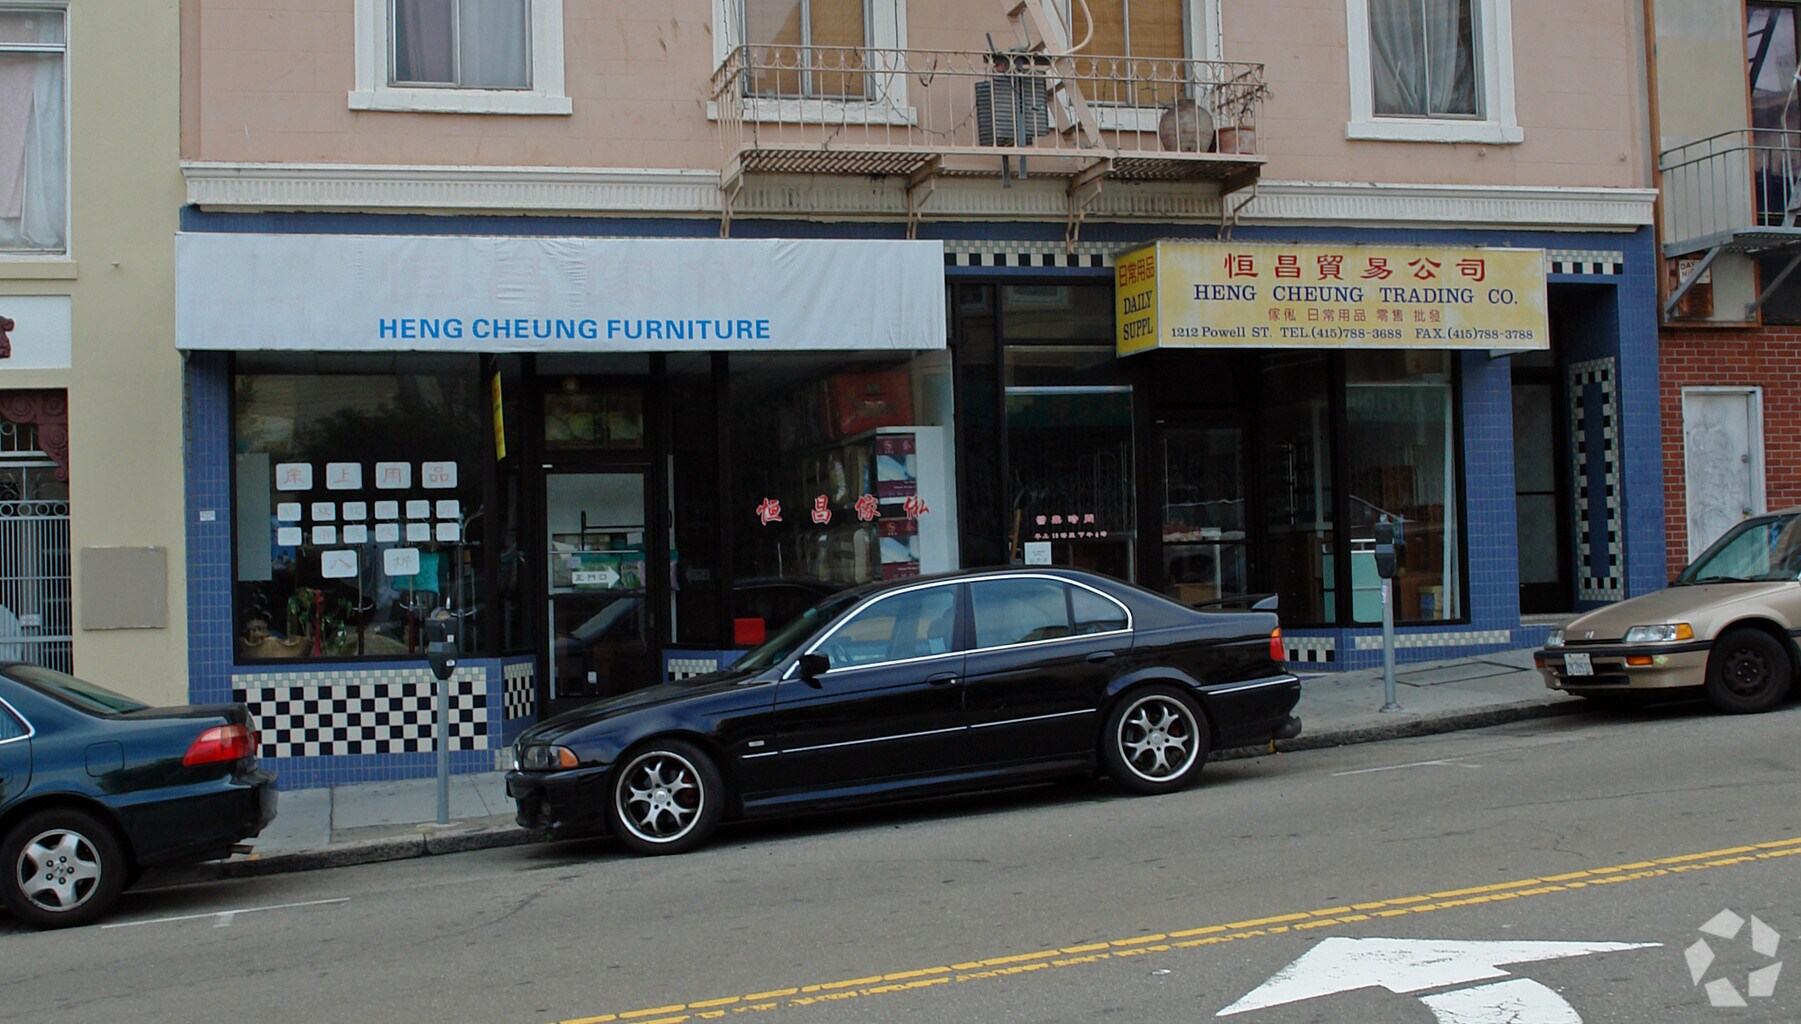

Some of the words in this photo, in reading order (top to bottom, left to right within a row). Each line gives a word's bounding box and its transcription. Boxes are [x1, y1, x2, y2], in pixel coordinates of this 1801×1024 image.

[1119, 256, 1155, 288] 日常用品
[1224, 252, 1486, 282] 恒昌貿易公司
[1123, 290, 1153, 315] DAILY
[1193, 284, 1258, 301] HENG
[1272, 285, 1364, 303] CHEUNG
[1379, 287, 1475, 304] TRADING
[1488, 288, 1519, 305] CO.
[1268, 308, 1296, 322] 傢俬
[1308, 308, 1366, 322] 日常用品
[1376, 309, 1404, 323] 零售
[1414, 309, 1442, 323] 批發
[378, 318, 463, 340] HENG
[471, 318, 598, 340] CHEUNG
[606, 318, 771, 340] FURNITURE
[1123, 317, 1154, 341] SUPPL
[1171, 327, 1199, 338] 1212
[1201, 326, 1246, 338] Powell
[1251, 327, 1272, 338] ST.
[1280, 327, 1402, 340] TEL.(415)788-3688
[1415, 327, 1534, 340] FAX.(415)788-3788
[756, 493, 930, 526] 恒昌傢俬
